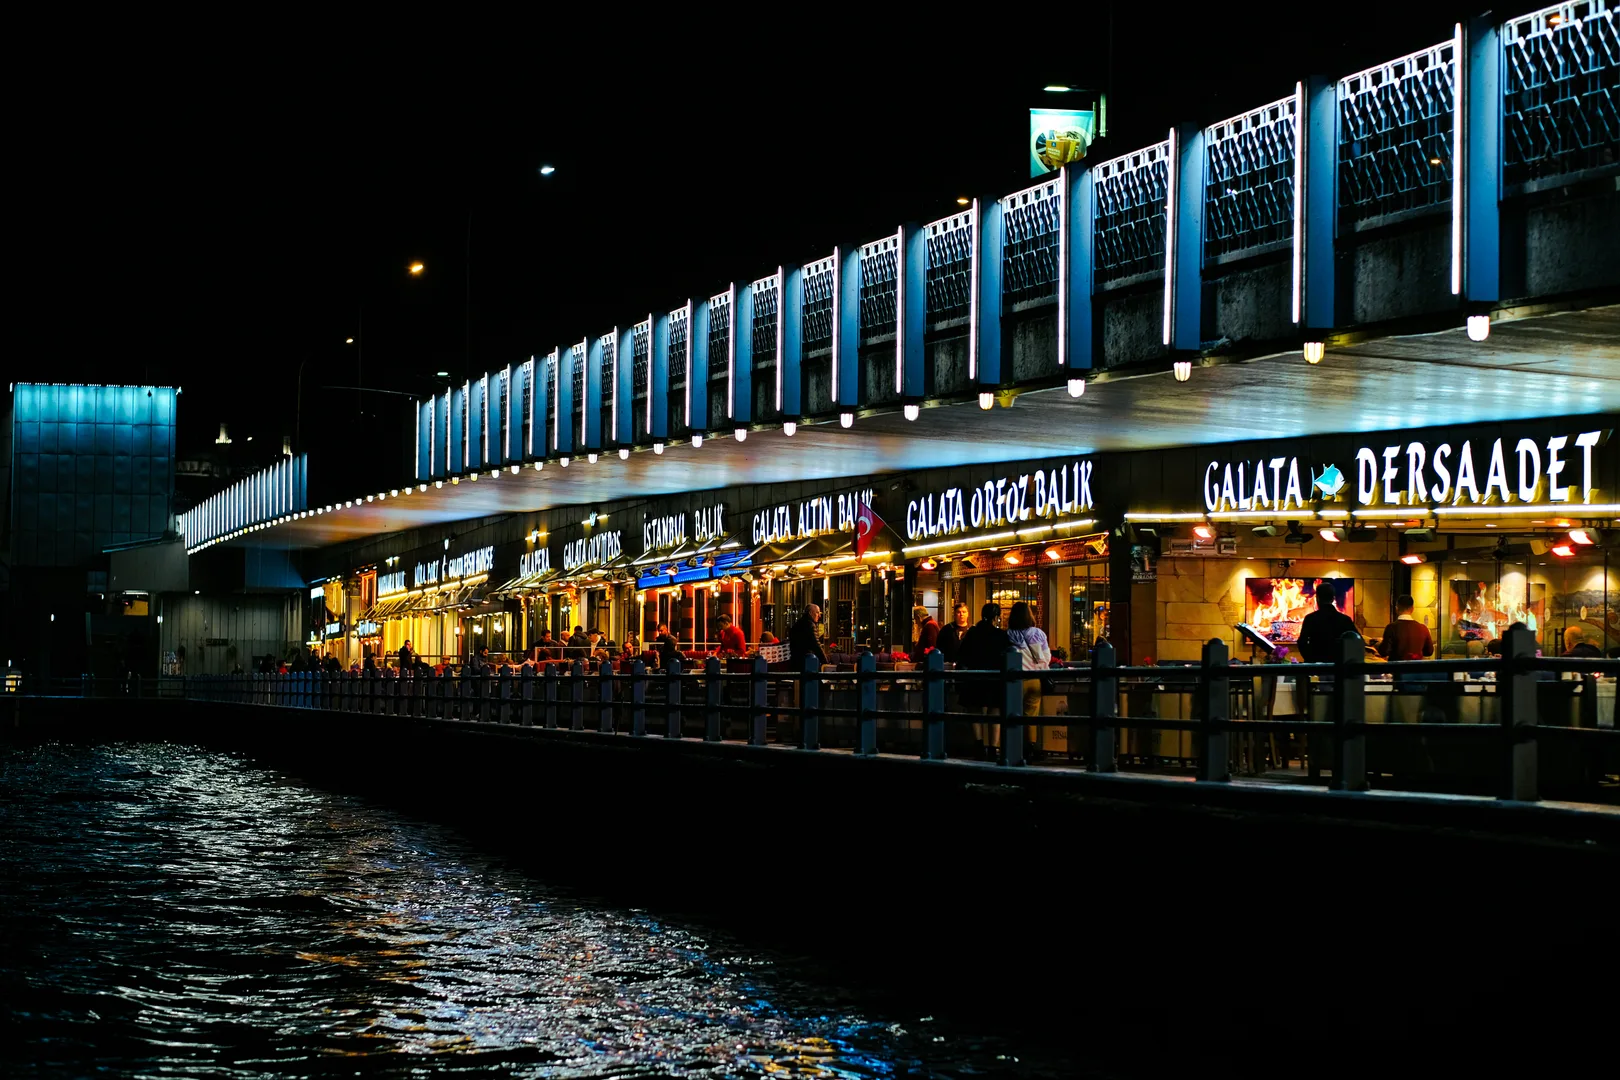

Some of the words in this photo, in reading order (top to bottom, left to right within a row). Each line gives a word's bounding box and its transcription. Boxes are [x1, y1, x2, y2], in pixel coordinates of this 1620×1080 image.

[907, 487, 966, 540] GALATA
[971, 474, 1030, 528] ORFOZ
[1034, 460, 1093, 516] BALIK
[1204, 457, 1303, 512] GALATA
[1356, 430, 1602, 505] DERSAADET
[694, 503, 724, 541] BALIK
[752, 504, 792, 545] GALATA
[797, 495, 833, 538] ALTIN
